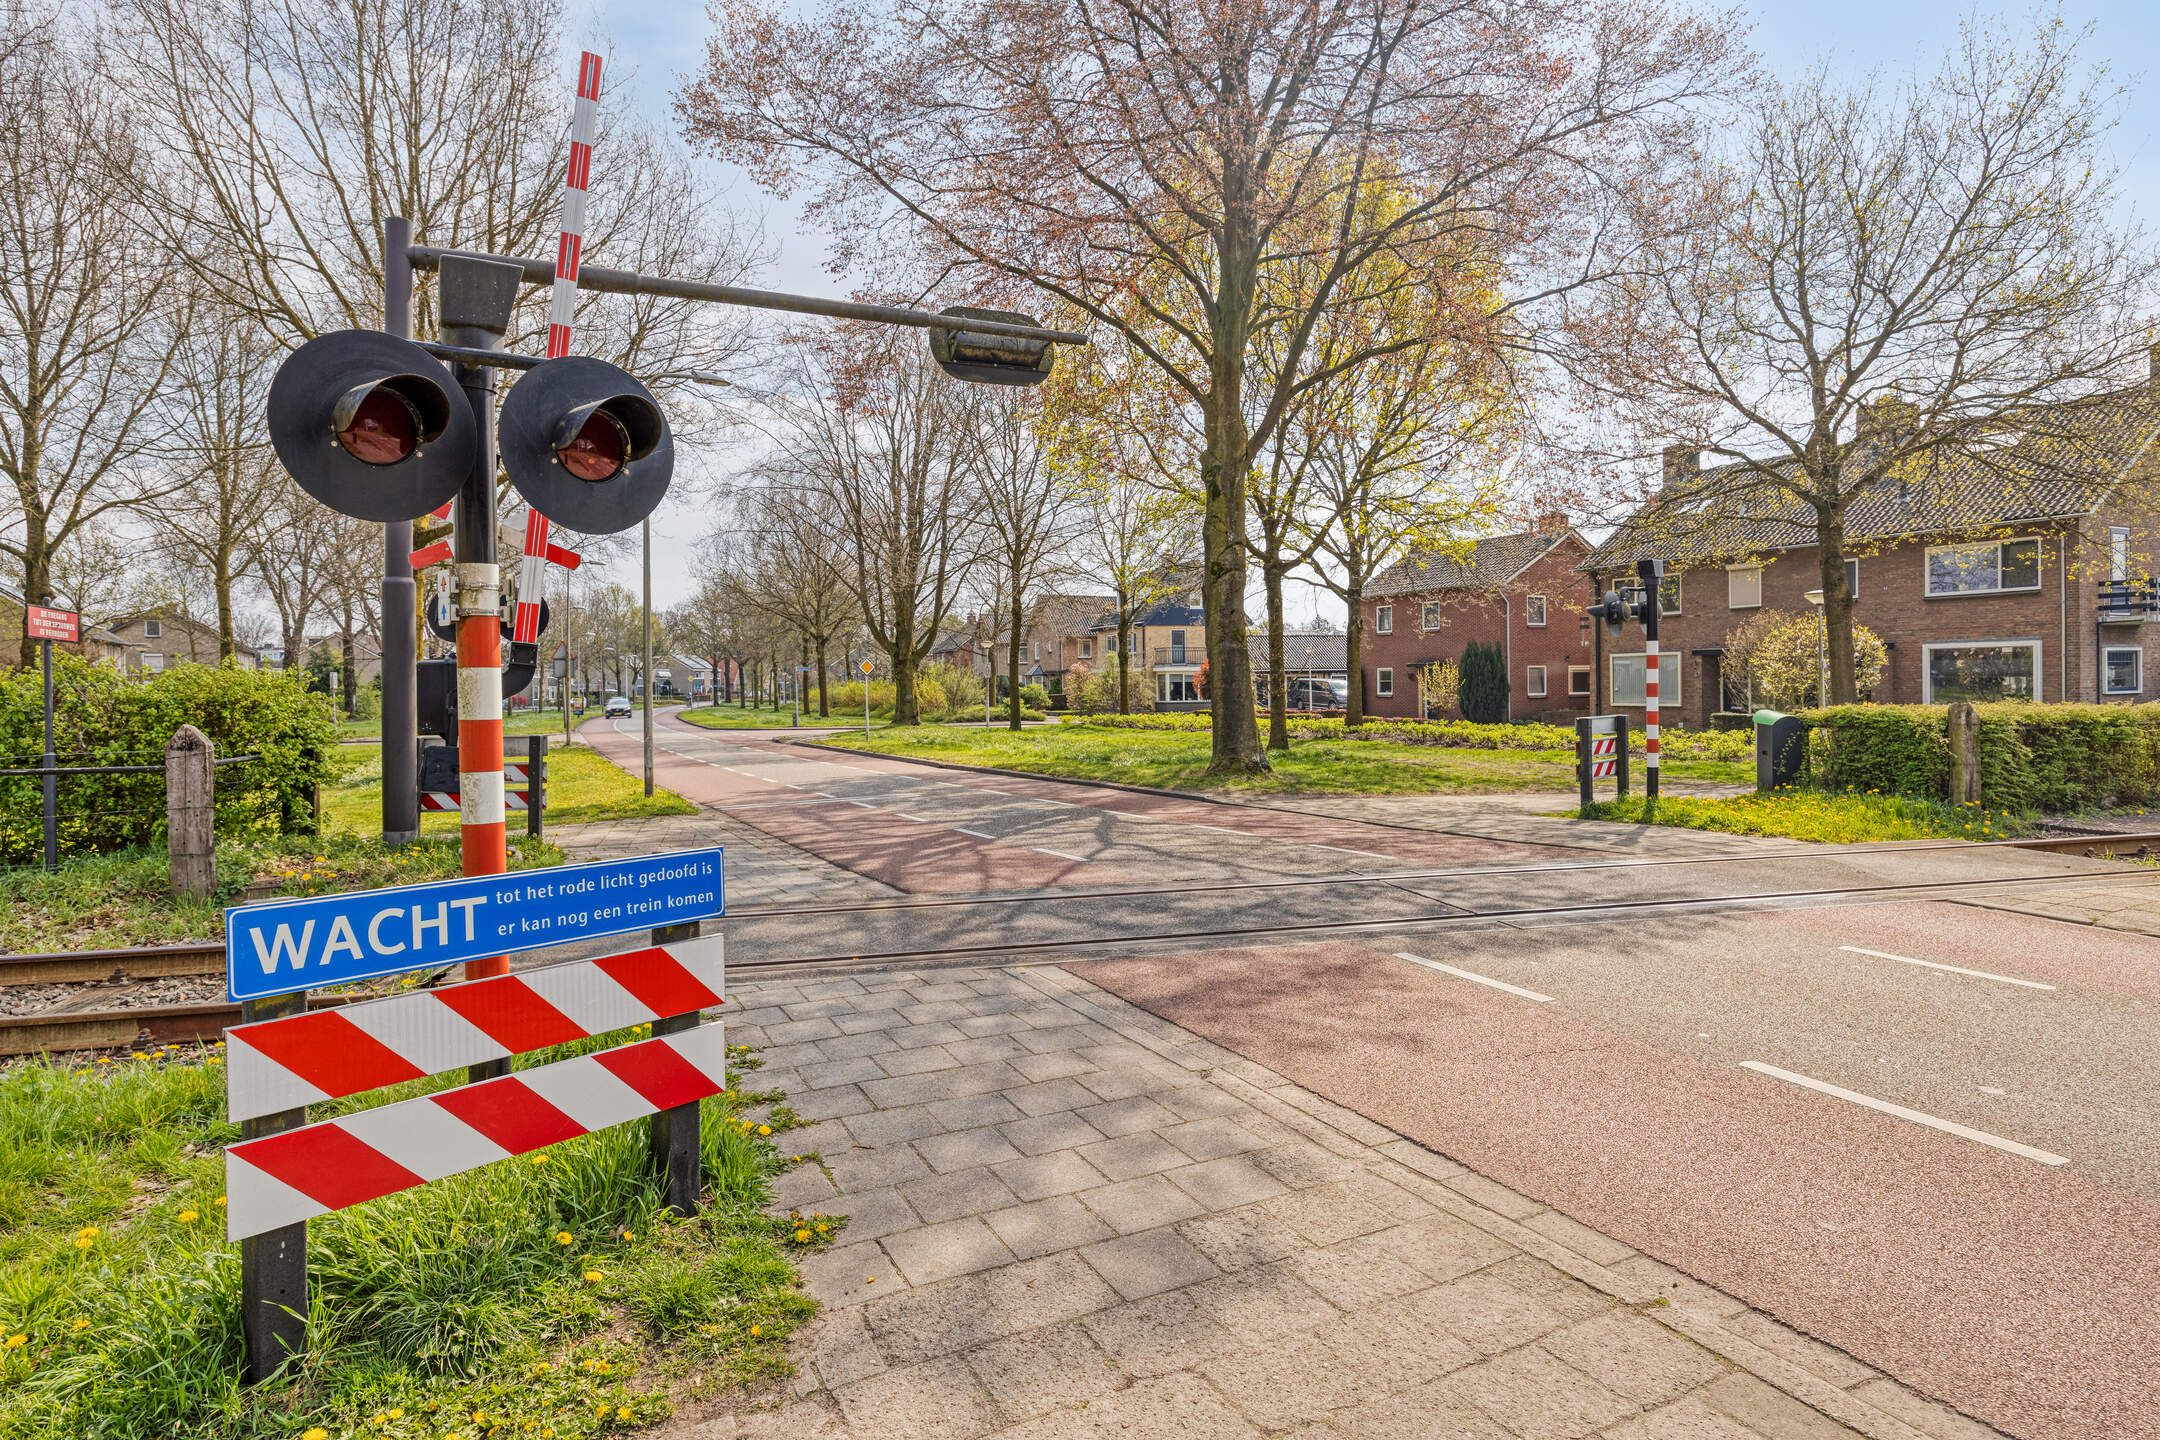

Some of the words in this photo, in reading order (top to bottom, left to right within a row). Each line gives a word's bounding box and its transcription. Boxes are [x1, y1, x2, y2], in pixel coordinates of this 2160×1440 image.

[496, 888, 521, 904] tot
[527, 884, 554, 900] het
[559, 878, 595, 895] rode
[600, 873, 635, 889] licht
[639, 863, 697, 888] gedoofd
[702, 862, 713, 875] is
[249, 895, 488, 975] WACHT
[498, 922, 516, 936] er
[521, 917, 551, 932] kan
[557, 911, 588, 927] nog
[593, 906, 621, 920] een
[626, 898, 662, 915] trein
[667, 891, 714, 909] komen
